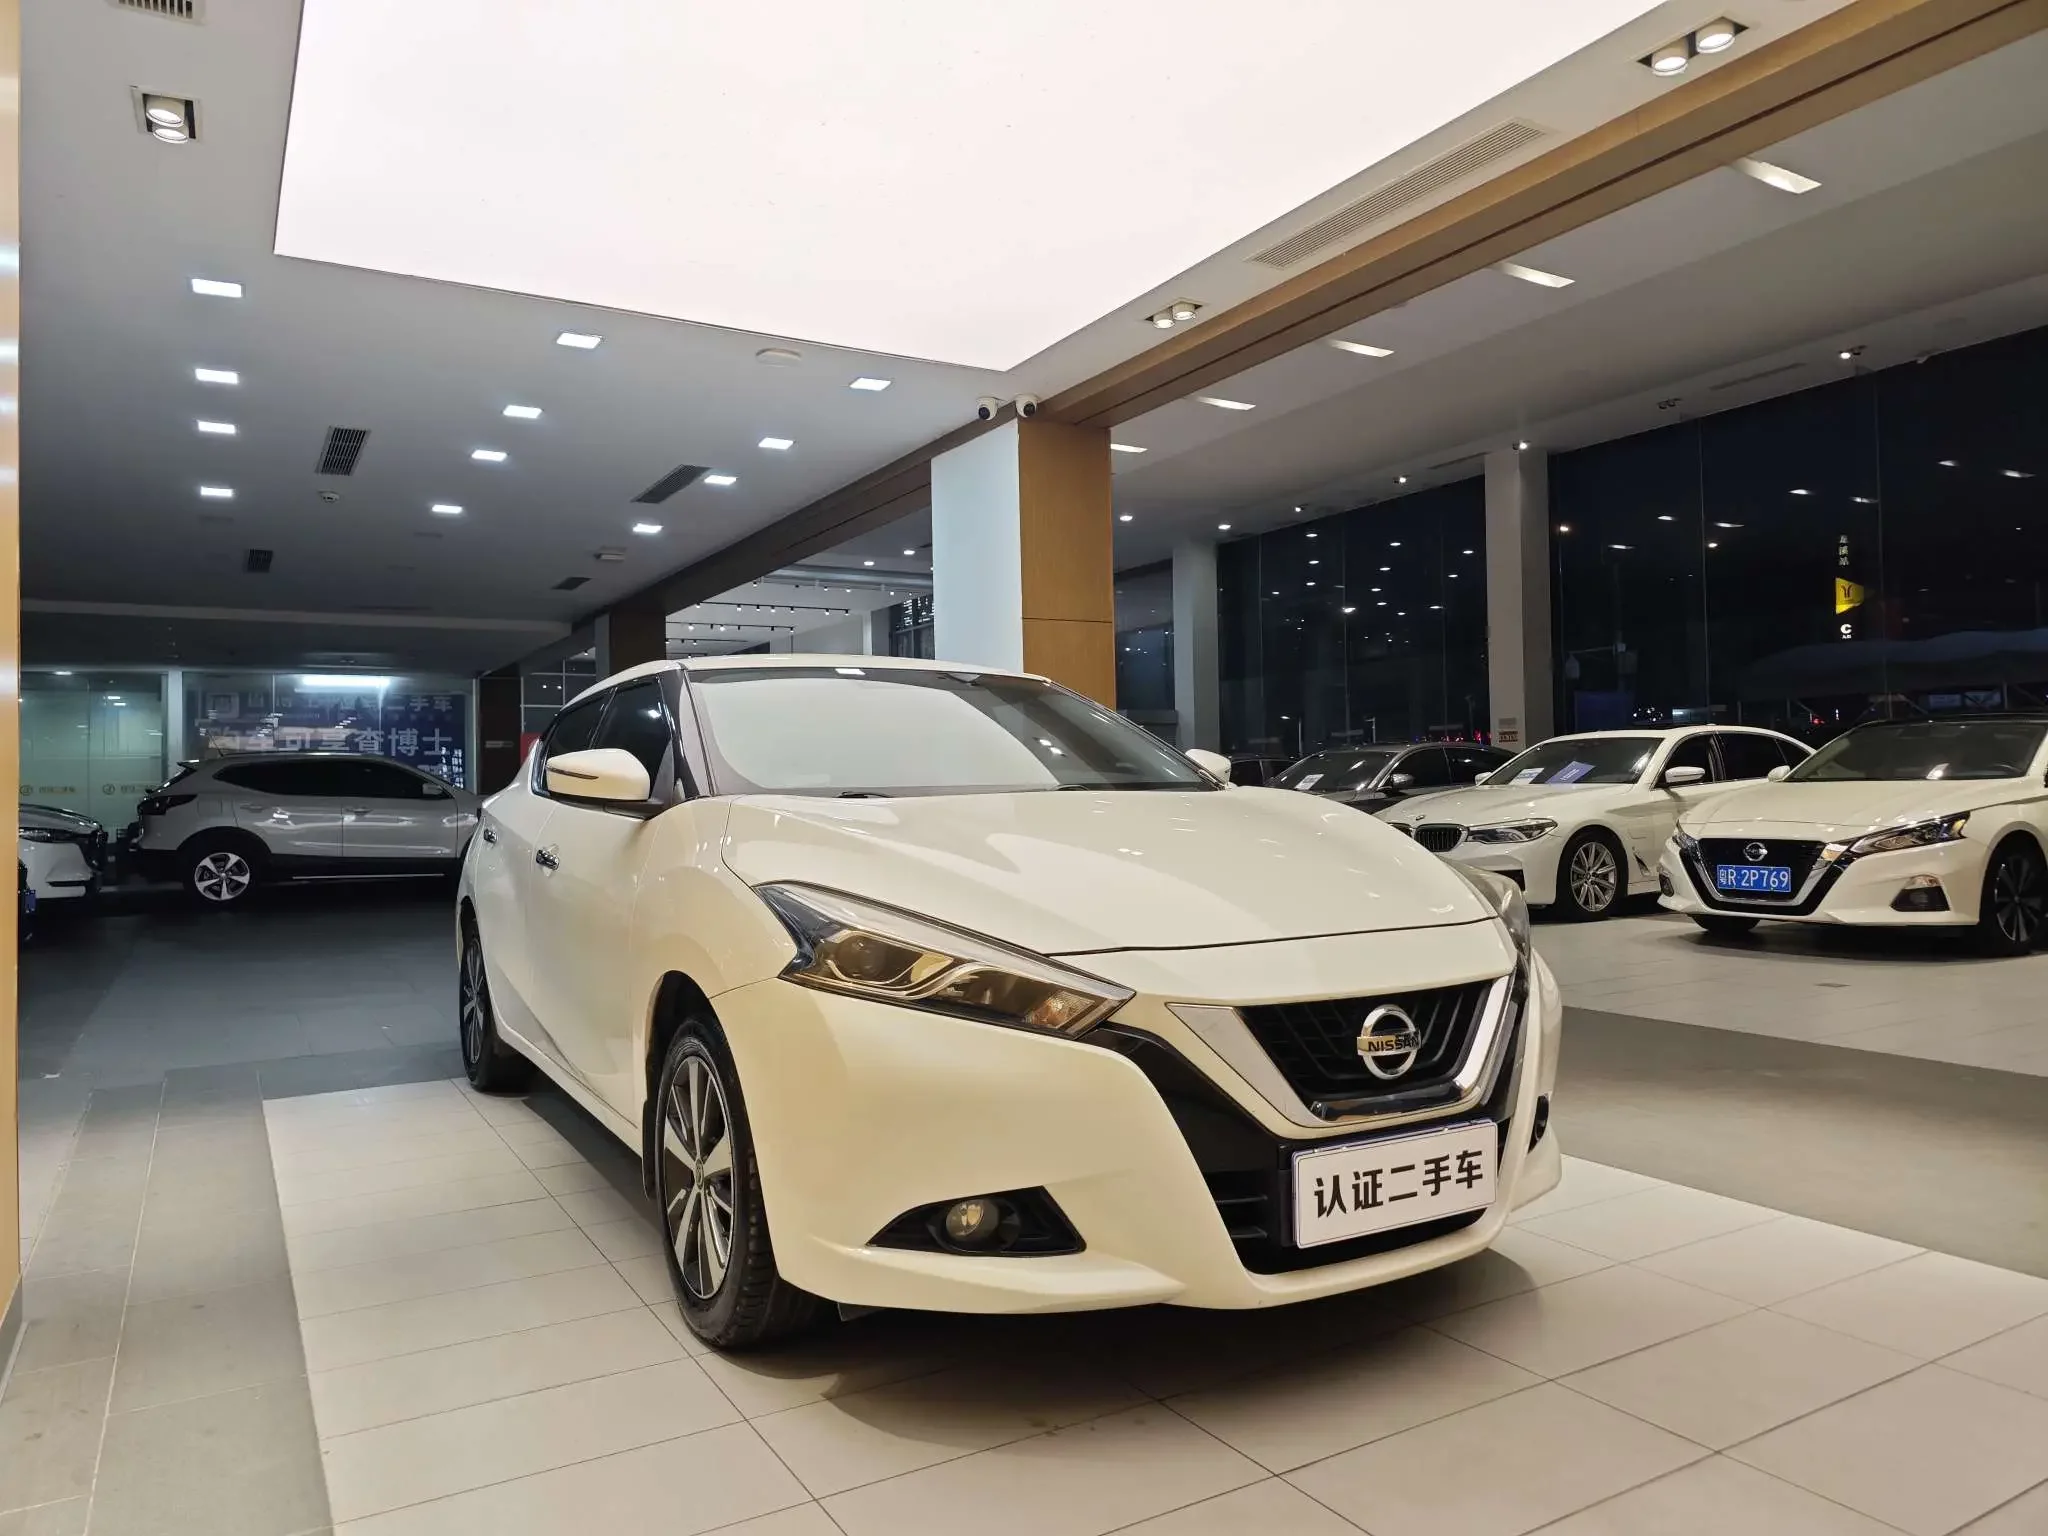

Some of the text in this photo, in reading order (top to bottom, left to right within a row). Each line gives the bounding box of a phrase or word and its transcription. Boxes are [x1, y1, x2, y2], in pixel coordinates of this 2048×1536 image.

[1840, 623, 1852, 634] C
[1368, 1036, 1419, 1052] NISSAN
[1313, 1150, 1484, 1218] 认证二手车
